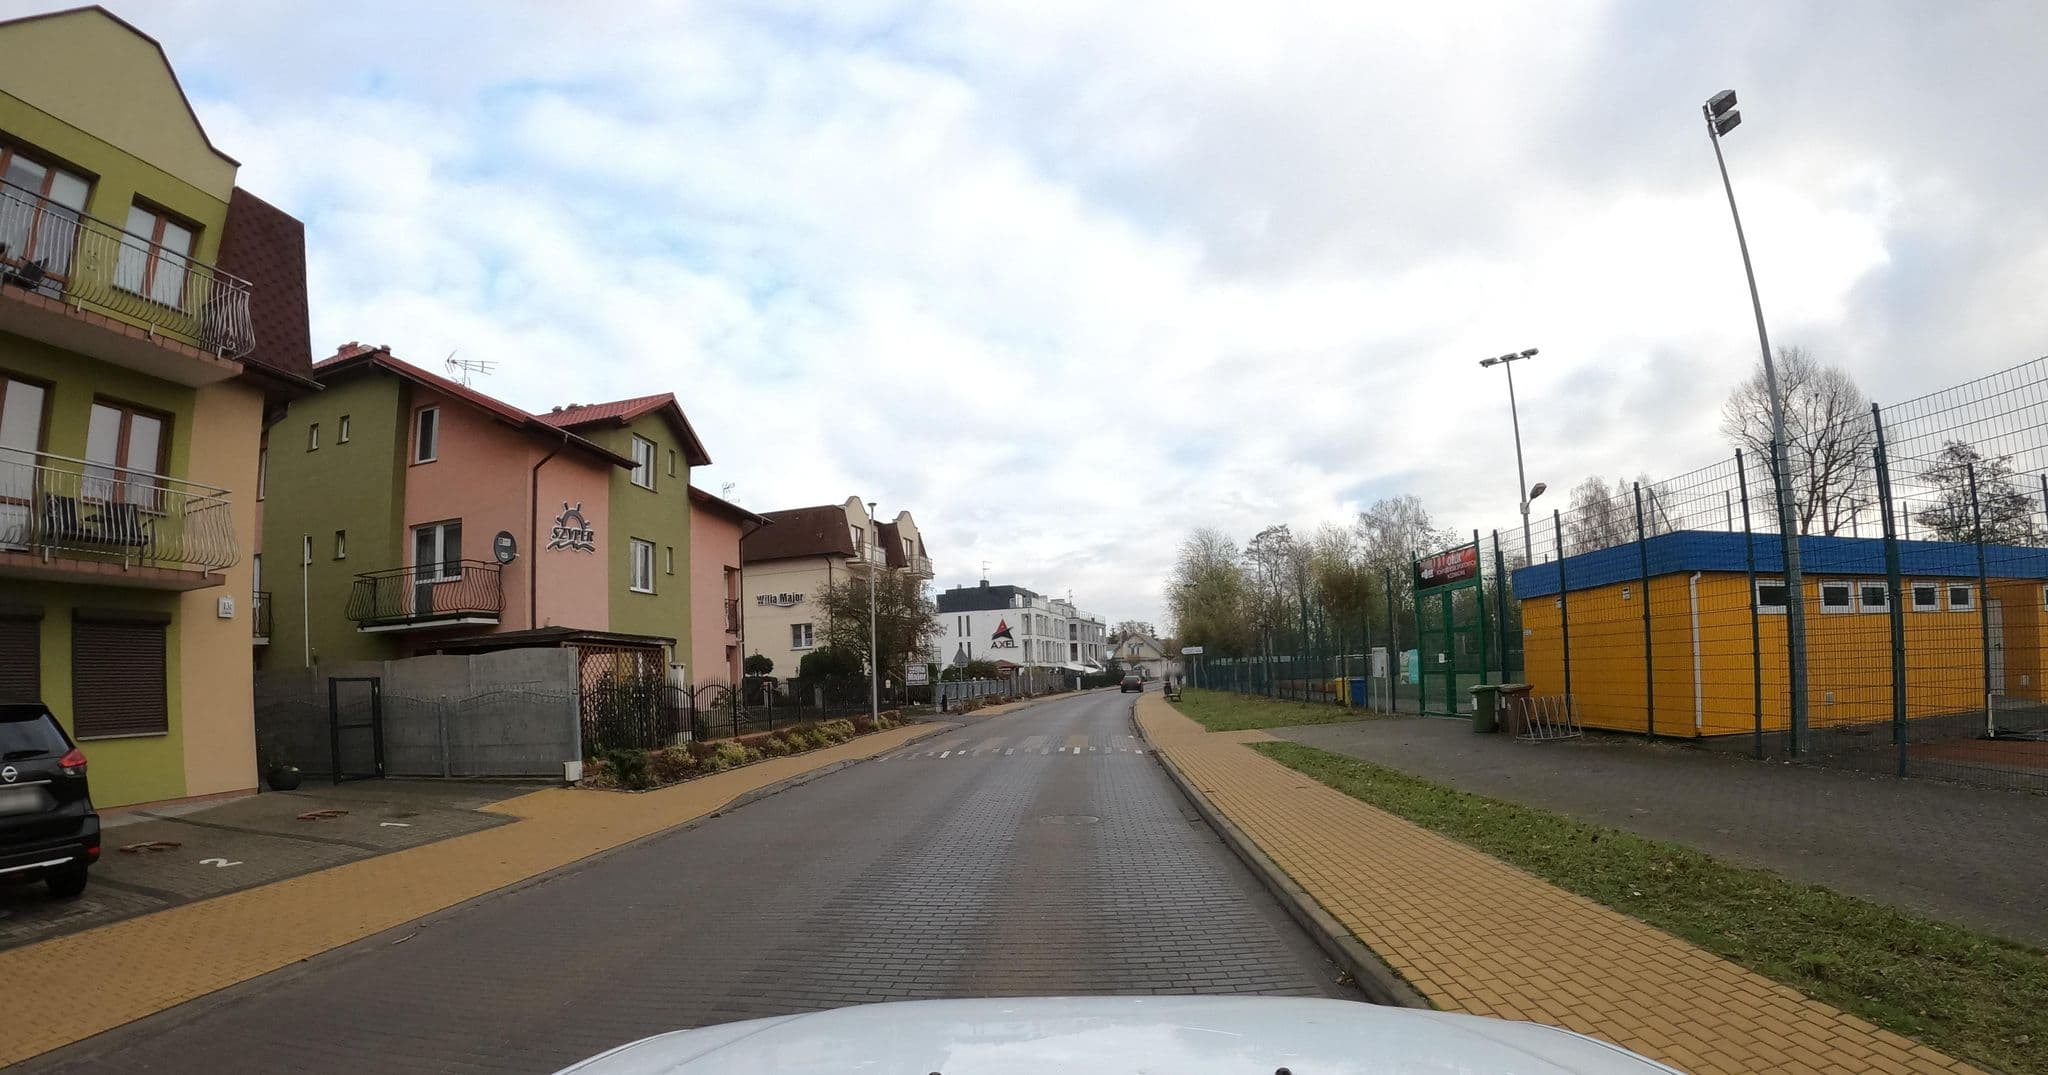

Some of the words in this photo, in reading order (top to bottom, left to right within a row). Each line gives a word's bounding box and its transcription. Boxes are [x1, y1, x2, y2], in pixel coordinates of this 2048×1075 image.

[552, 527, 594, 542] SZYPER
[991, 640, 1019, 649] AXEL
[199, 858, 244, 868] 2
